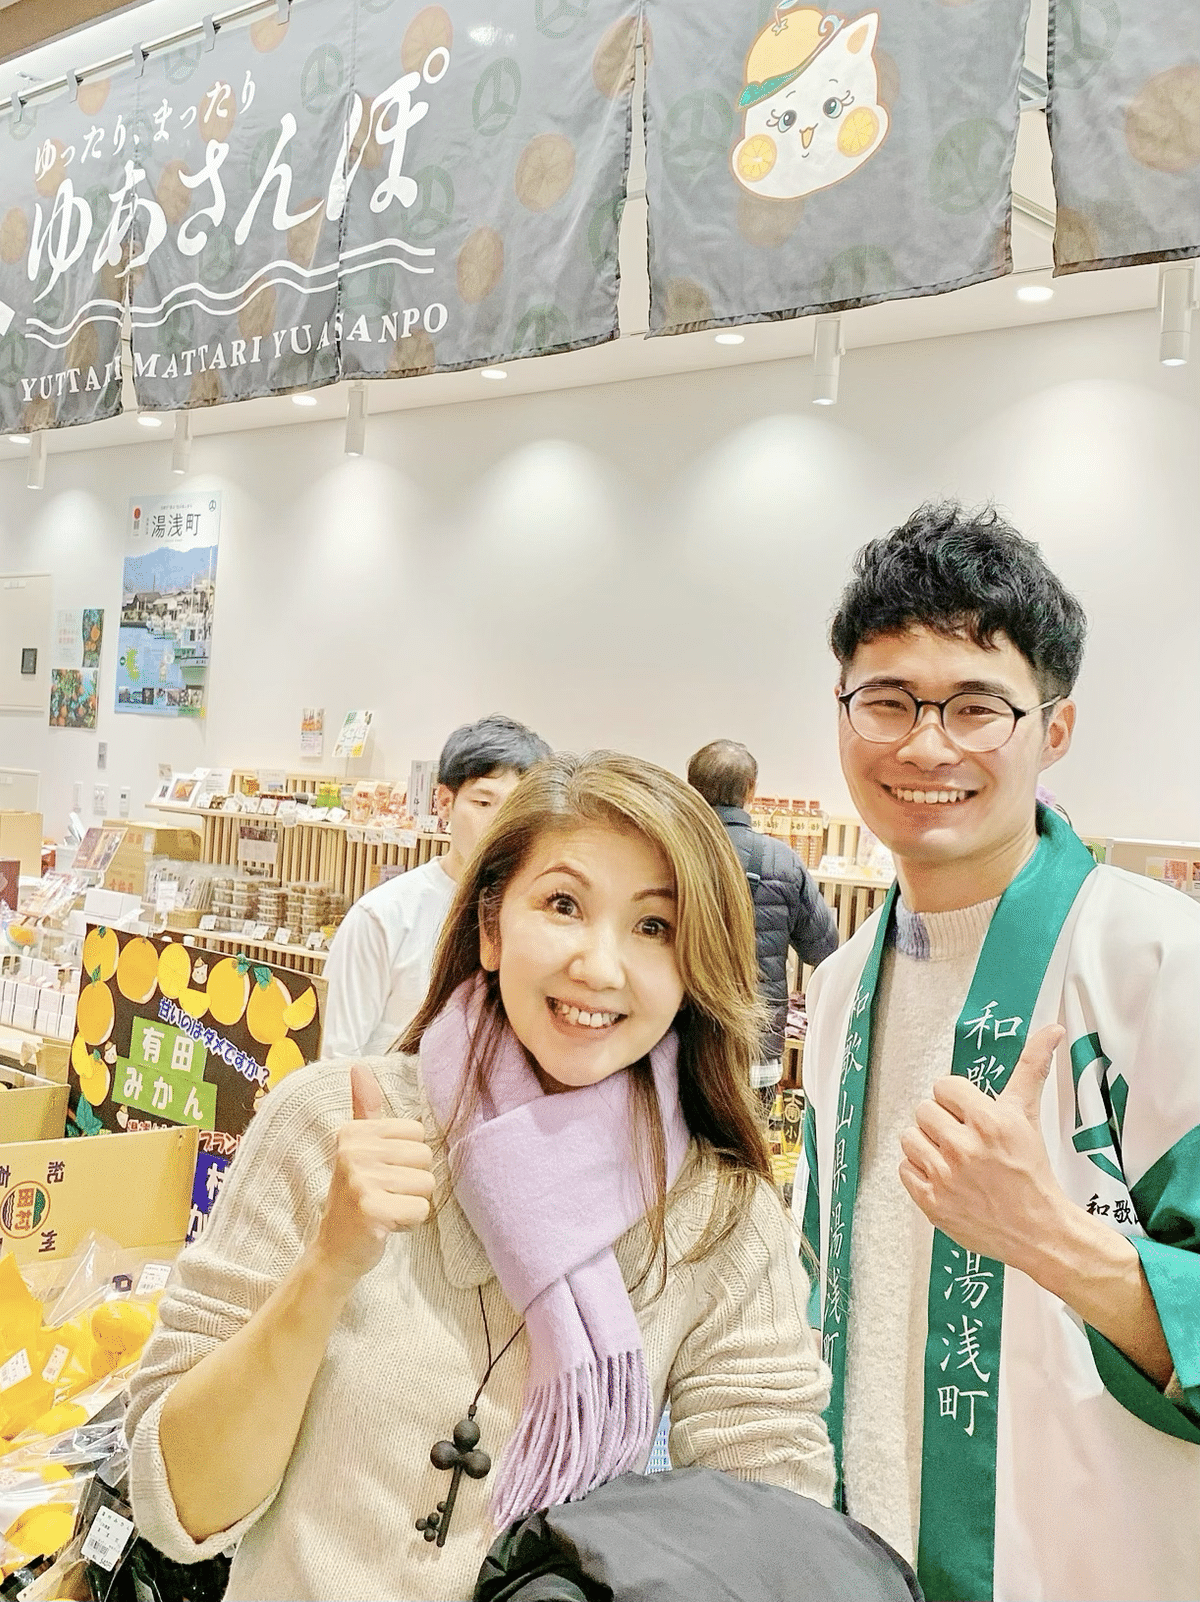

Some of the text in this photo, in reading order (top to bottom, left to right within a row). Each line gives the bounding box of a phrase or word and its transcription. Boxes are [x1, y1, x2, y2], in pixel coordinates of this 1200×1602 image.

[27, 47, 451, 303] ゆあさんぽ
[134, 336, 262, 378] MATTARI
[151, 513, 201, 538] 湯浅町
[143, 1027, 194, 1072] 有田
[123, 1067, 204, 1121] みかん
[14, 1188, 35, 1231] 田村
